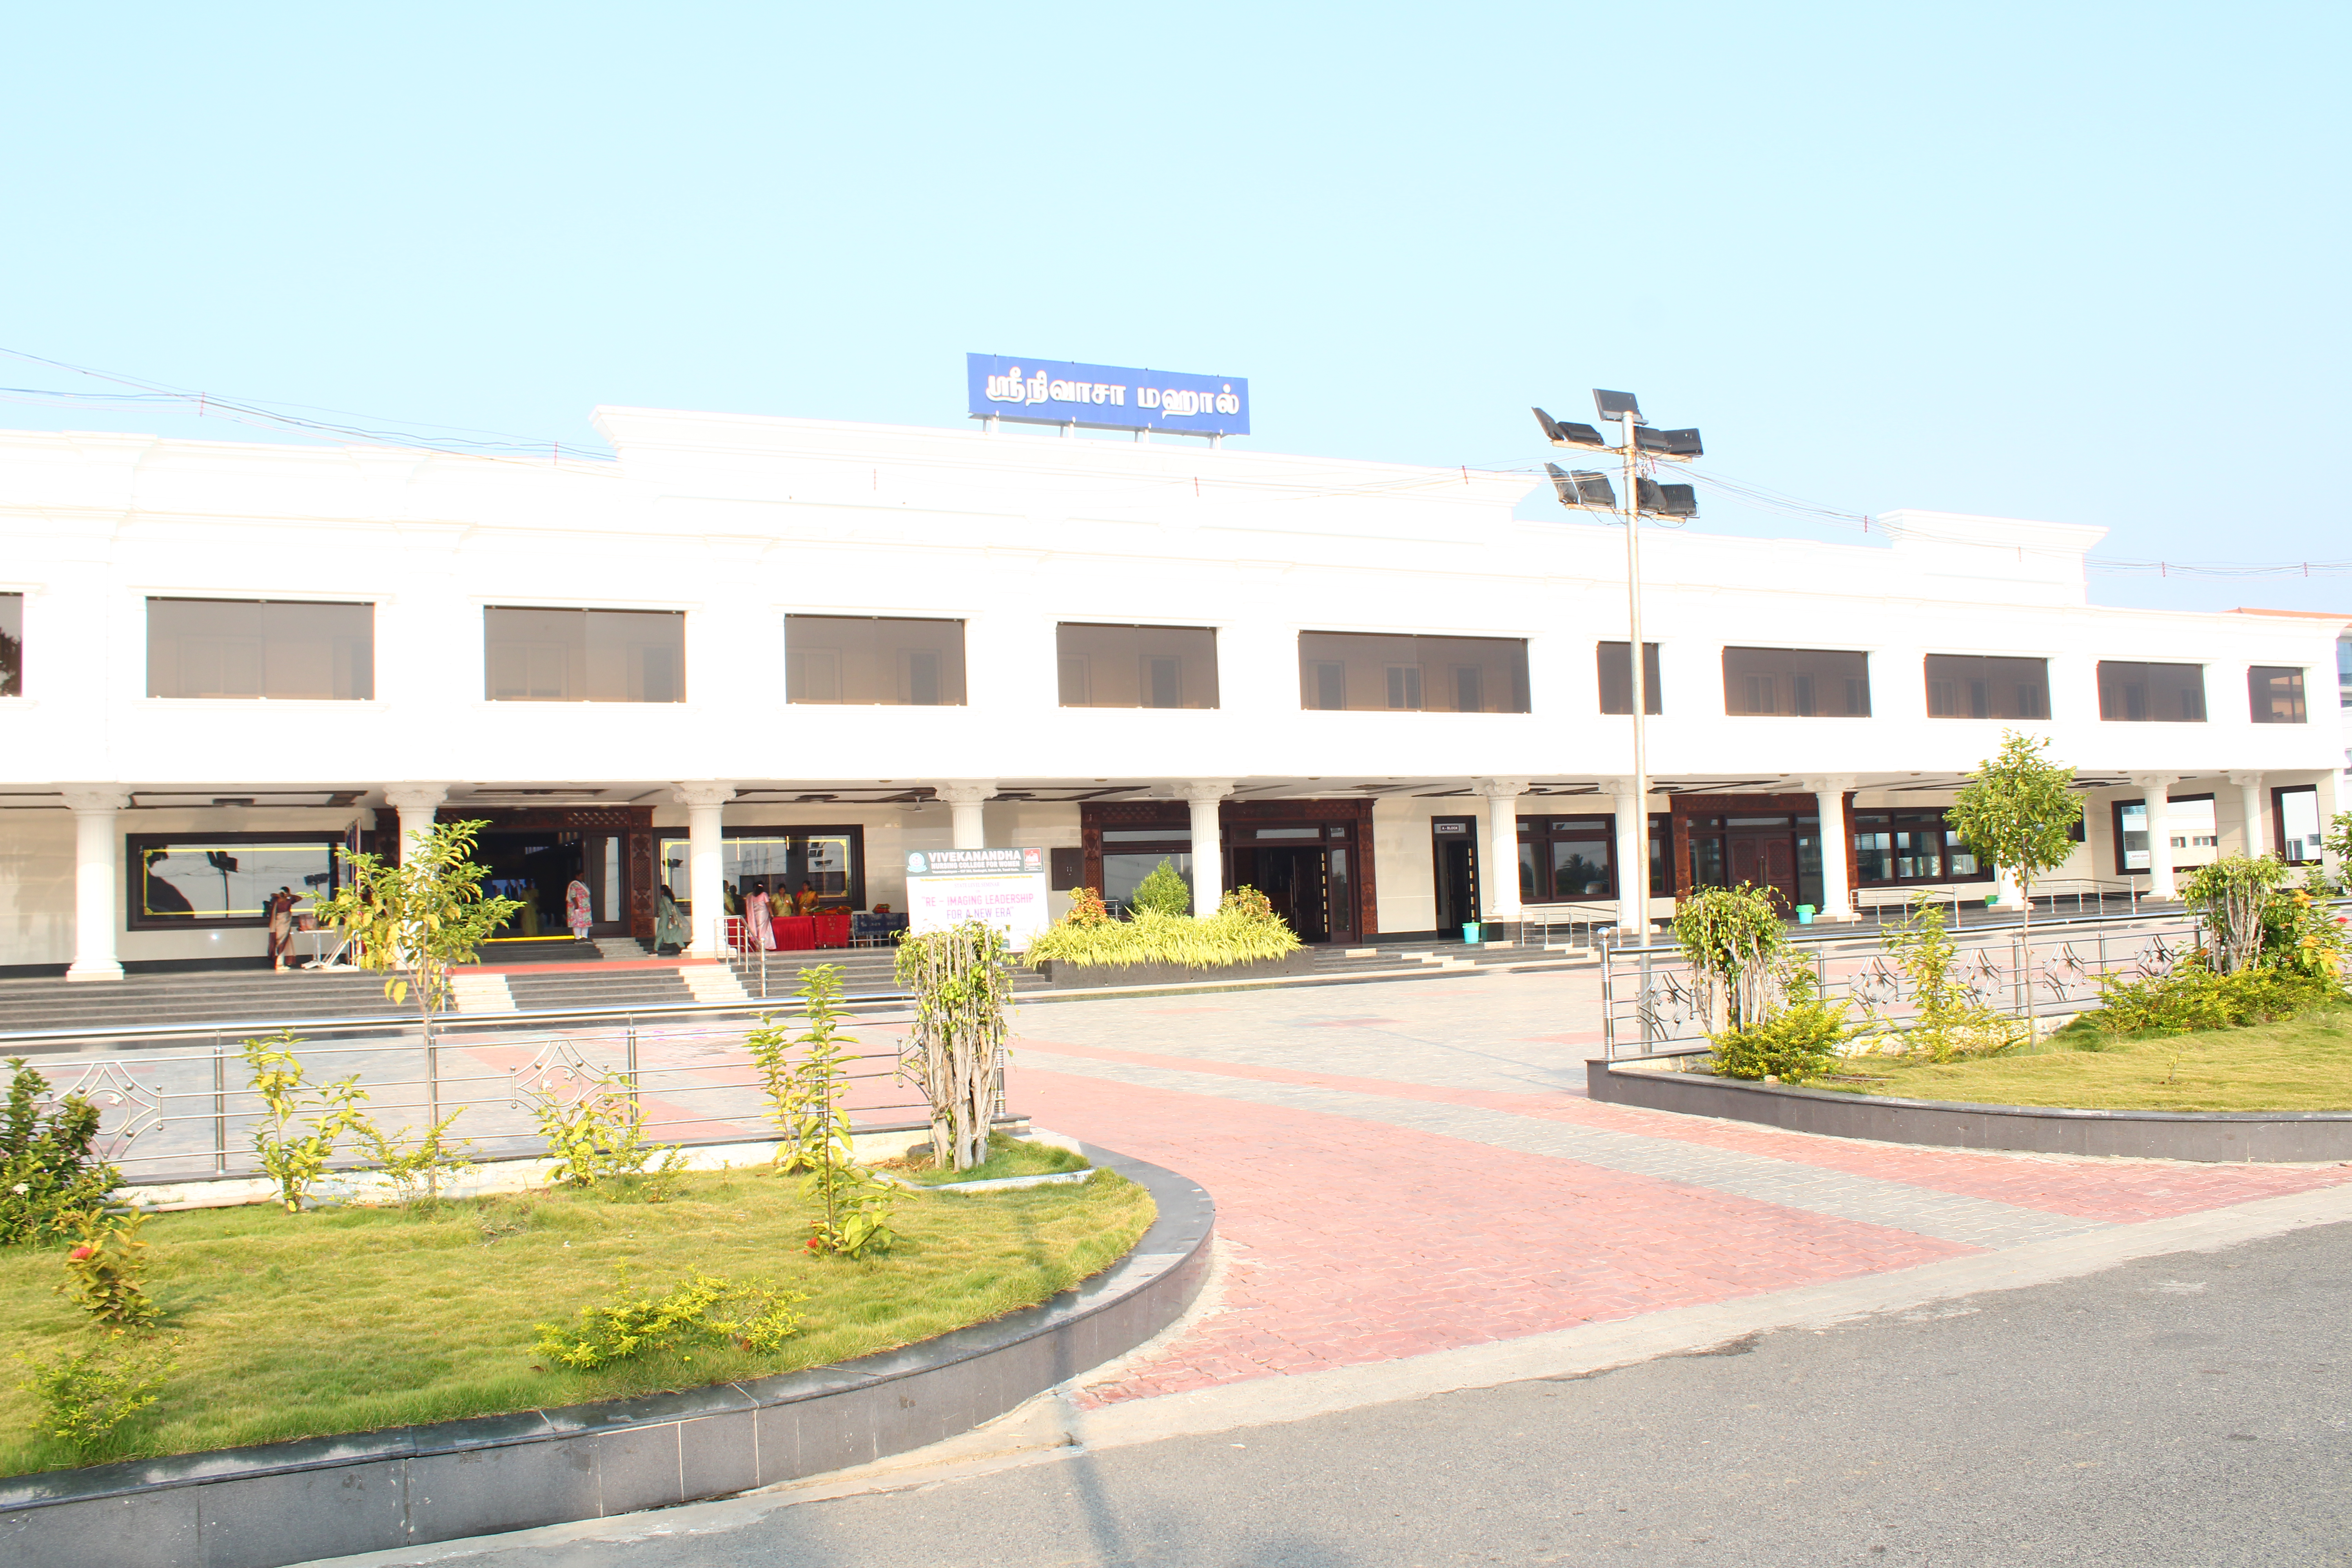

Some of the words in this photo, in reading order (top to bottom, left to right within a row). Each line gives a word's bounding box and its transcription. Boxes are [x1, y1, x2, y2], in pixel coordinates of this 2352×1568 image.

[1138, 384, 1240, 419] மஹால்
[928, 850, 1022, 862] VIVEKANANDHA
[947, 895, 982, 906] IMAGING
[985, 893, 1034, 905] LEADERSHIP
[947, 909, 962, 919] FOR
[966, 909, 971, 919] A
[974, 908, 992, 918] NEW
[996, 906, 1014, 918] ERA"
